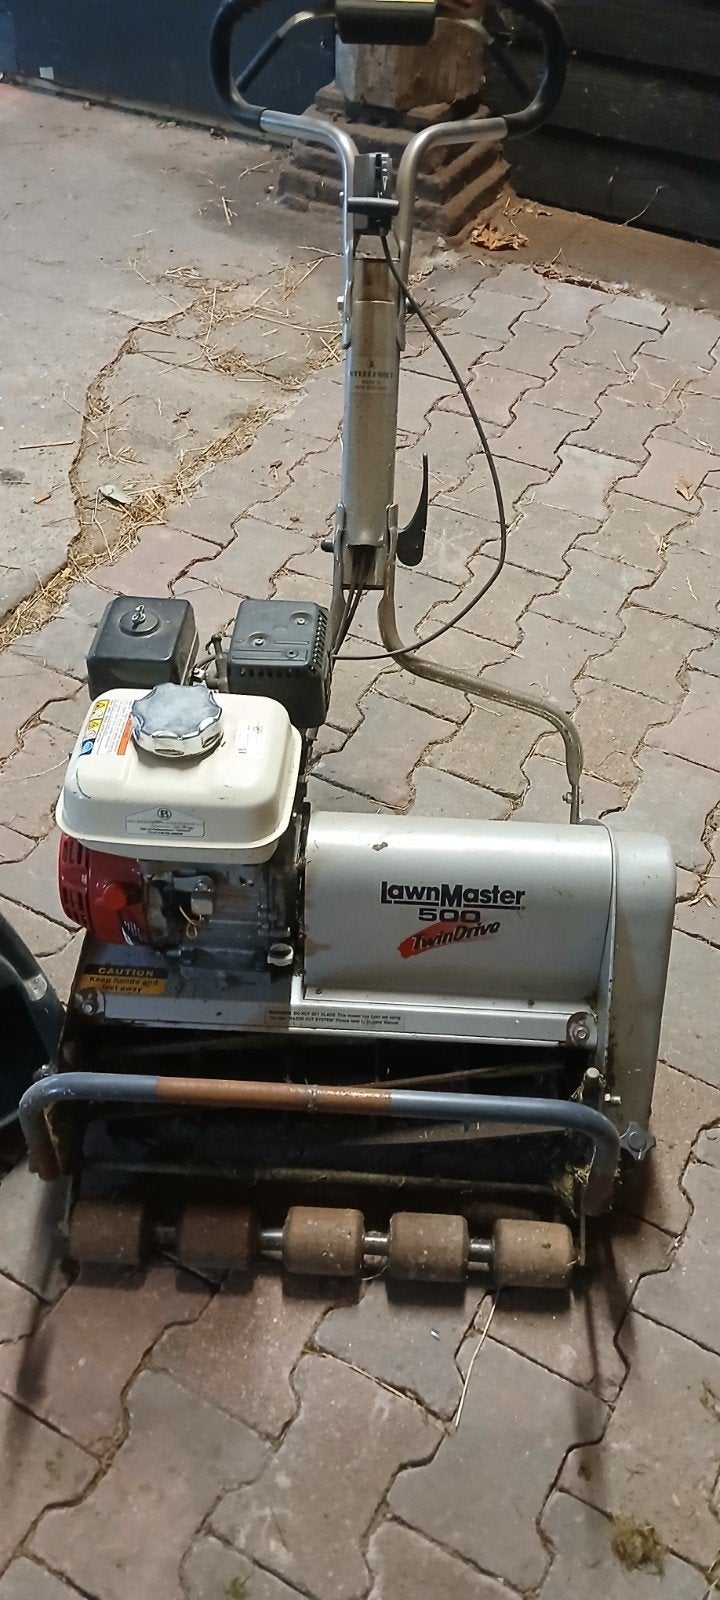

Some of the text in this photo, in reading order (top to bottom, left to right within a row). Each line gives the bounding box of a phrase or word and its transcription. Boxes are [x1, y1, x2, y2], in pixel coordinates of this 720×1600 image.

[381, 881, 526, 909] LawnMaster
[418, 908, 481, 923] 500
[411, 922, 500, 950] TwinDrive
[98, 967, 154, 977] CAUTION
[89, 976, 160, 987] Keep hands and
